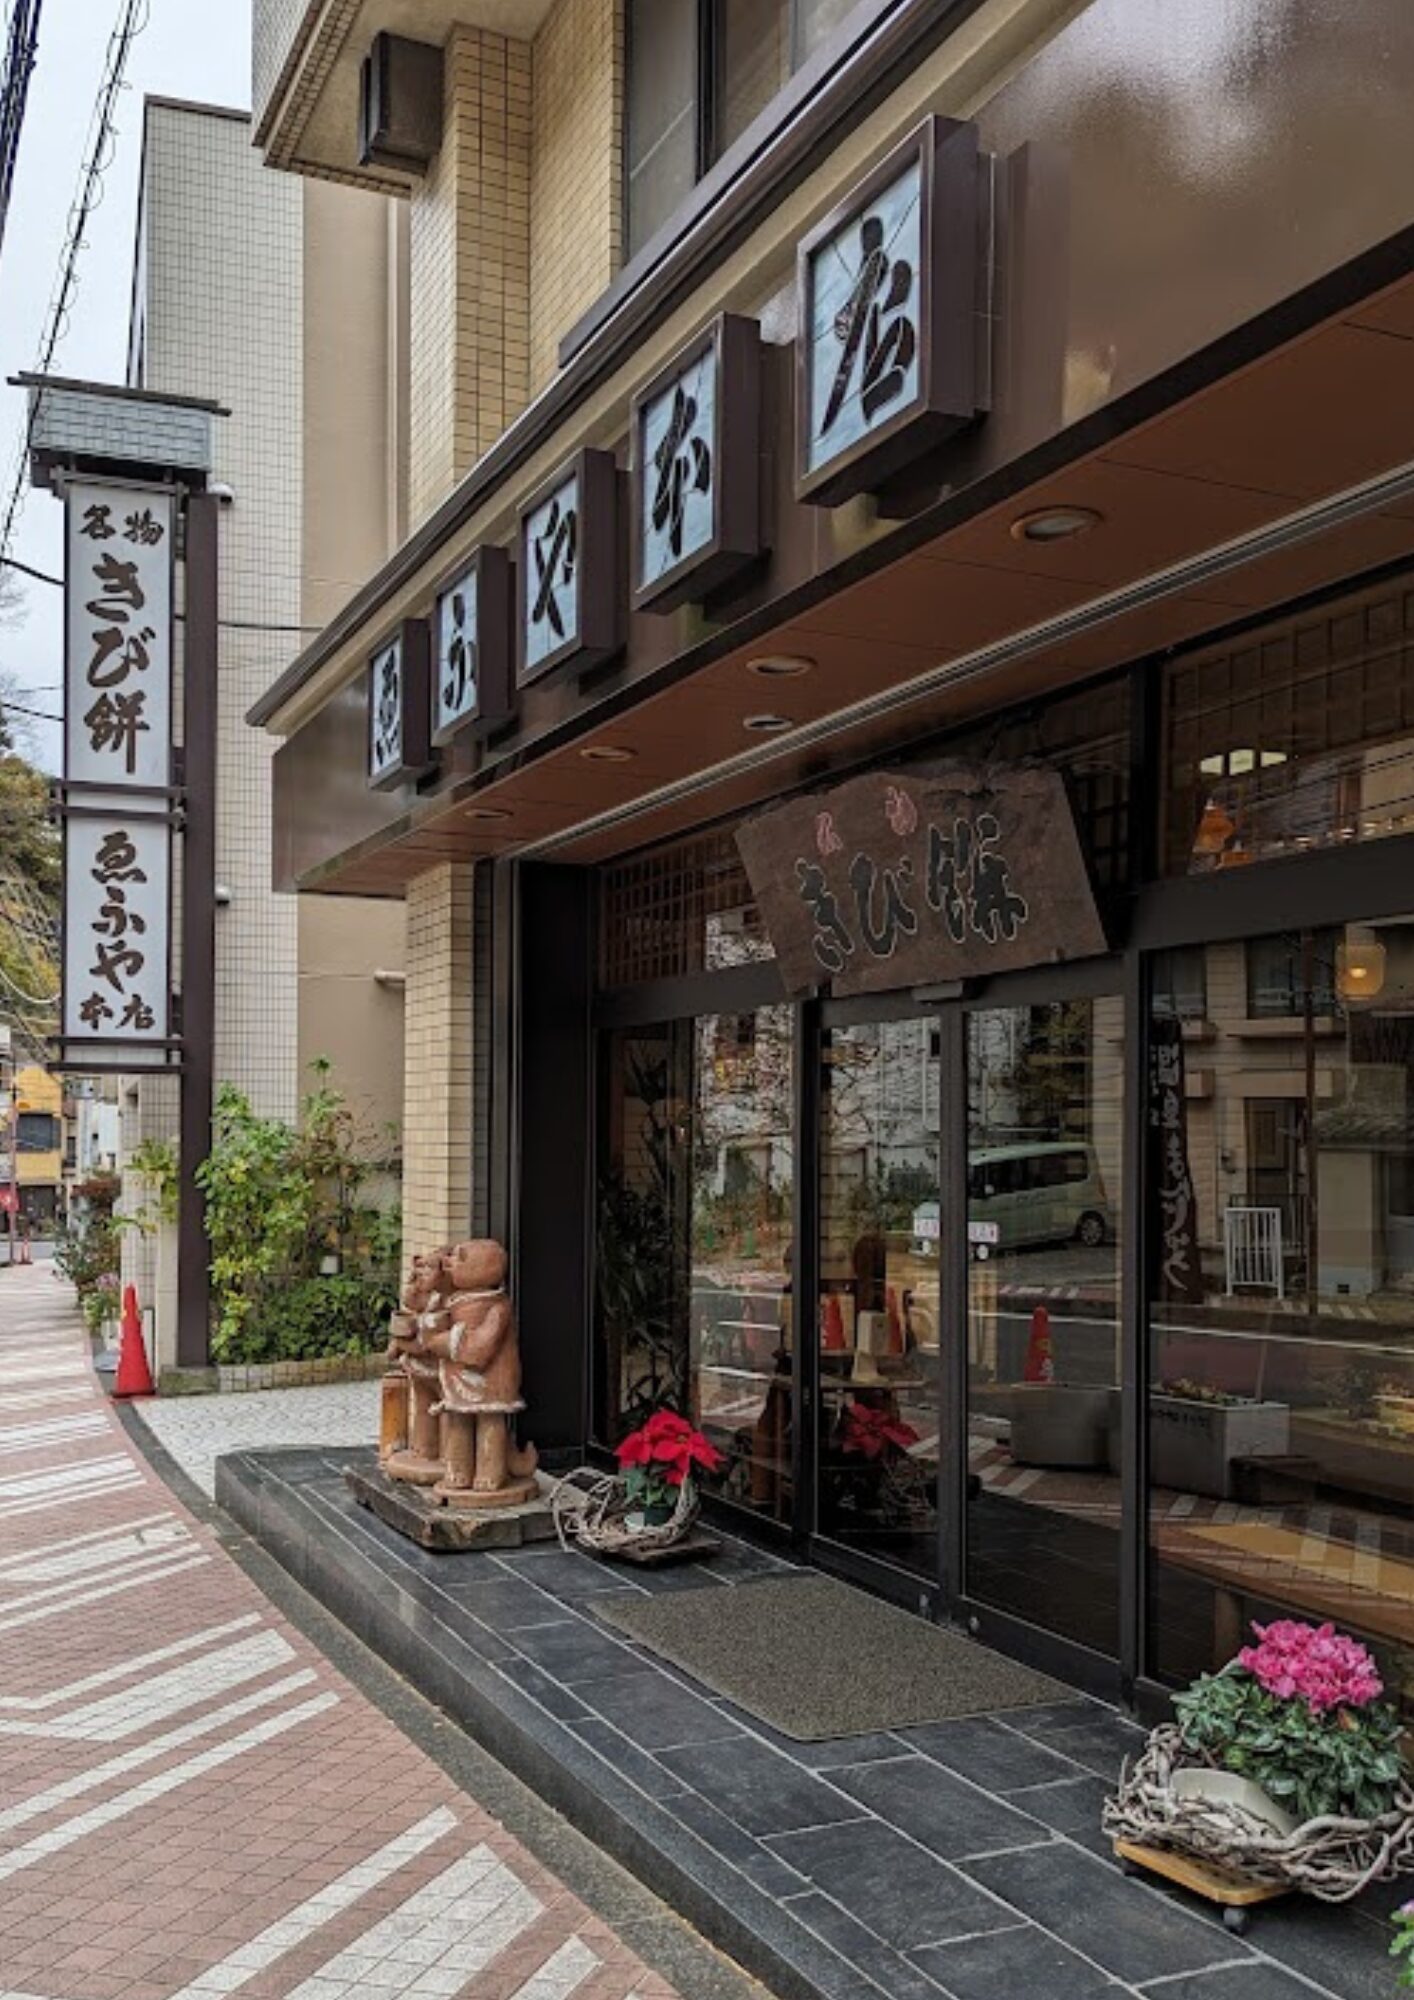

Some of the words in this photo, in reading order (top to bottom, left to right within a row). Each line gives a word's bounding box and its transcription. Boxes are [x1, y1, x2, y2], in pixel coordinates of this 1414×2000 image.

[78, 503, 166, 547] 名物
[82, 551, 158, 774] きび餅
[90, 830, 147, 995] ゑふや
[79, 994, 156, 1030] 本店
